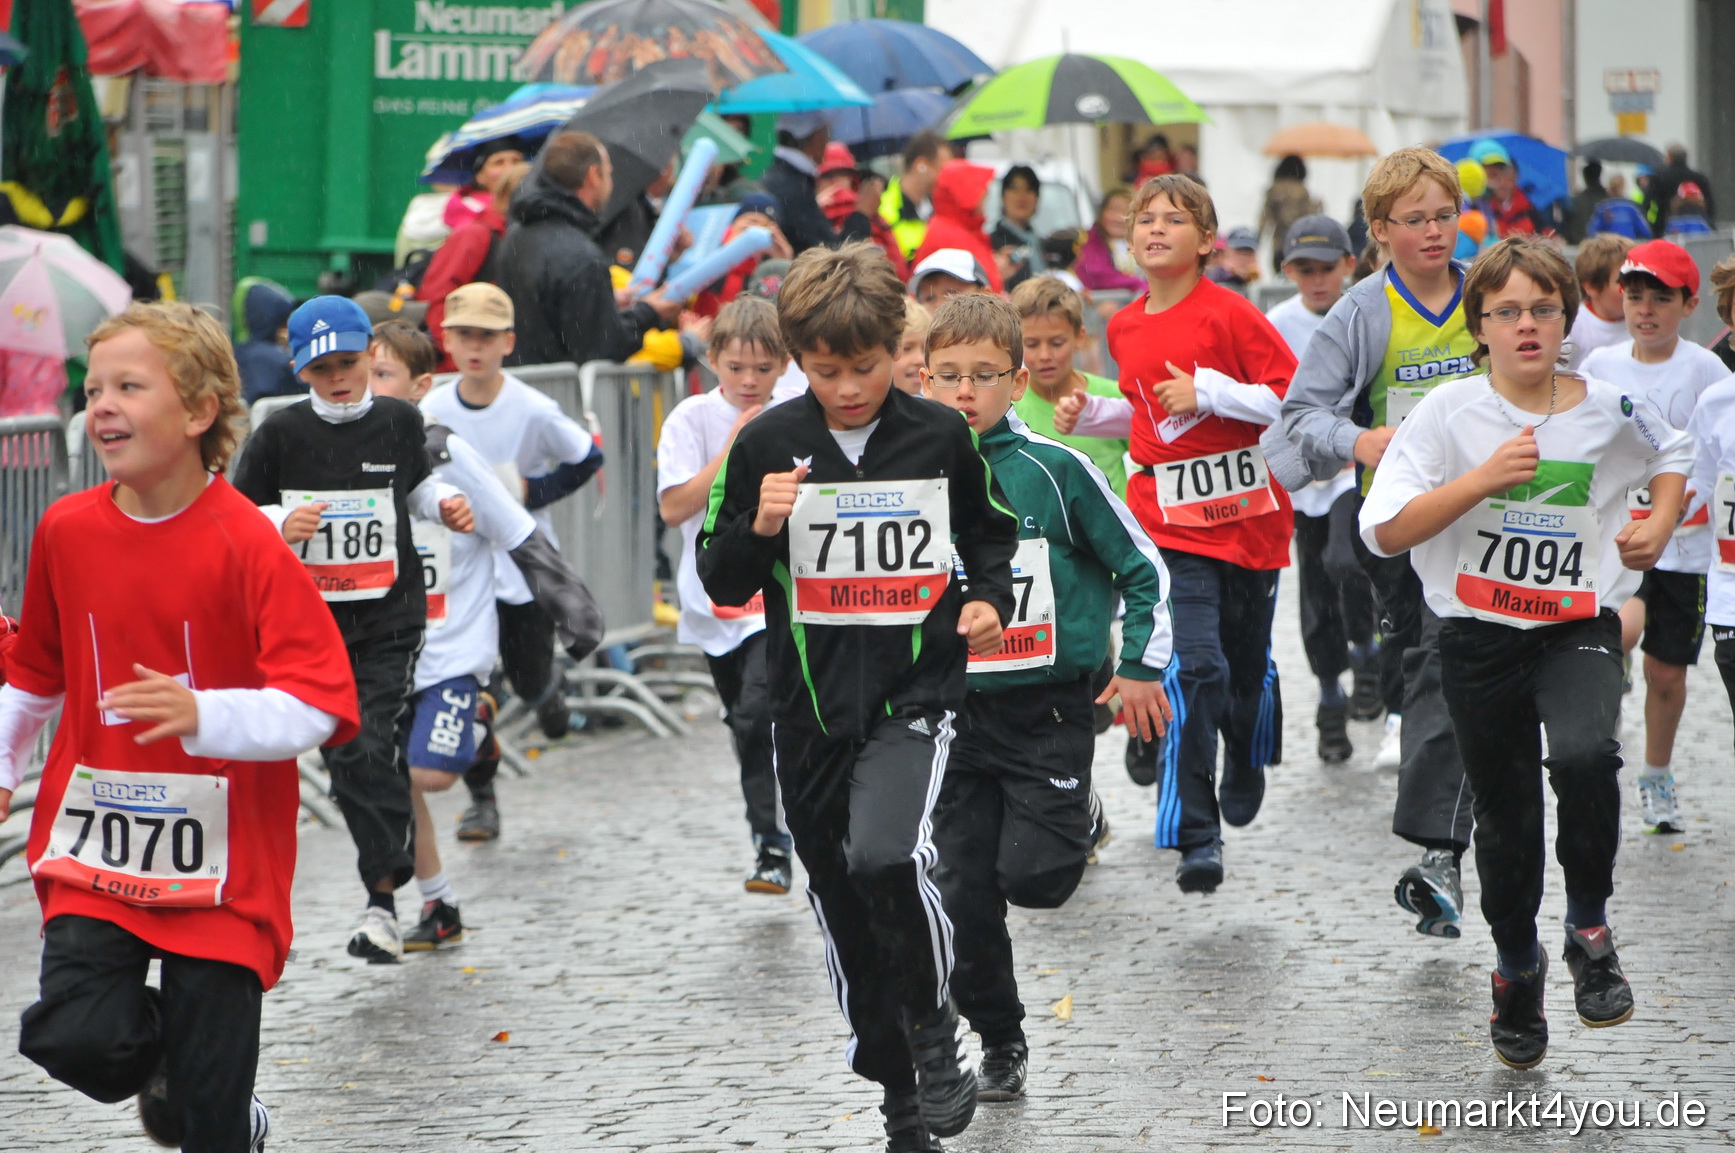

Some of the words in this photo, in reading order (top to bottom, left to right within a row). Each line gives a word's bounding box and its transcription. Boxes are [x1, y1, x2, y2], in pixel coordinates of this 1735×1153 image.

[1398, 343, 1451, 362] TEAM
[1395, 355, 1476, 381] BOCK
[1166, 450, 1256, 501] 7016
[313, 499, 362, 511] OCK
[836, 491, 904, 509] BOCK
[1203, 504, 1239, 522] Nico
[1503, 511, 1565, 528] BOCK
[1024, 516, 1036, 529] C.
[808, 519, 935, 573] 7102
[1477, 530, 1584, 586] 7094
[797, 565, 804, 575] 6
[1461, 563, 1469, 572] 6
[1585, 580, 1594, 590] M
[830, 583, 919, 607] Michael
[1491, 588, 1560, 617] Maxim
[1041, 612, 1050, 622] M
[93, 781, 167, 802] BOCK
[65, 808, 204, 874] 7070
[209, 865, 219, 876] M
[91, 873, 161, 900] Louis
